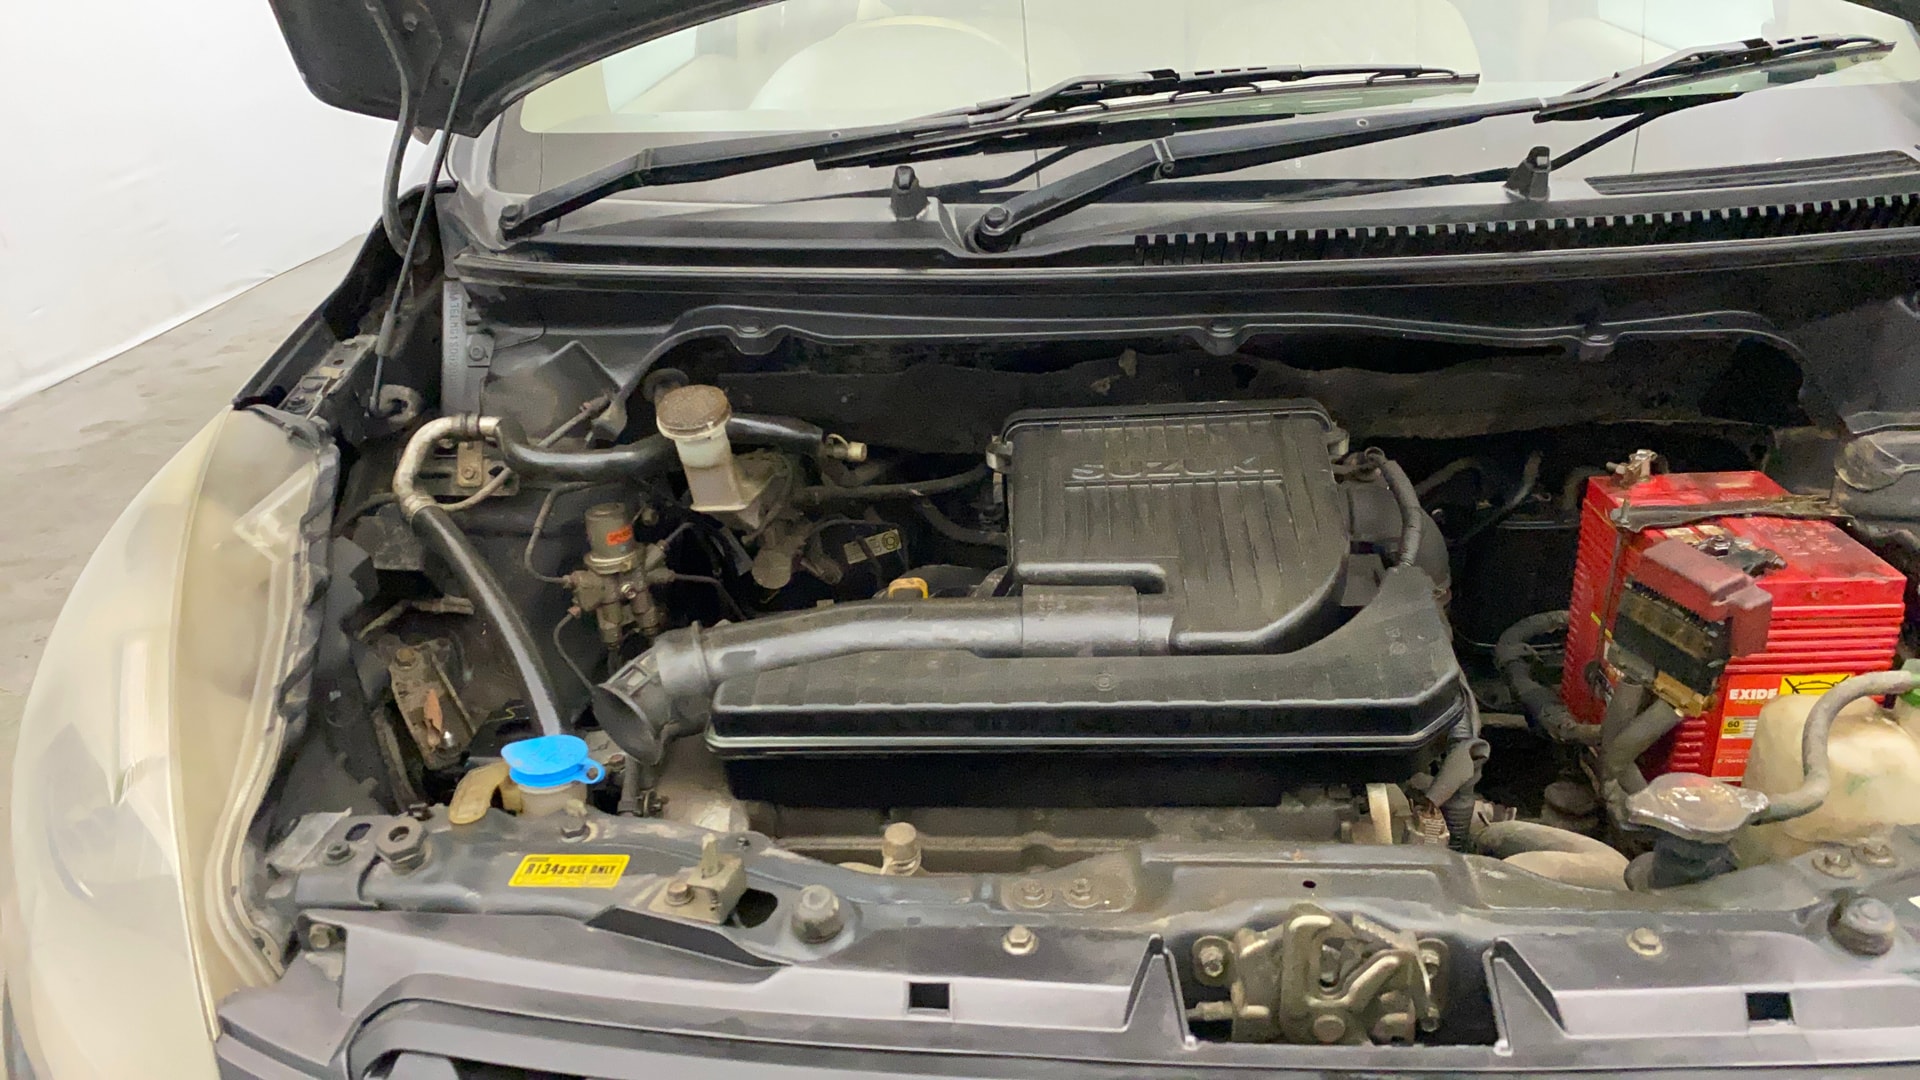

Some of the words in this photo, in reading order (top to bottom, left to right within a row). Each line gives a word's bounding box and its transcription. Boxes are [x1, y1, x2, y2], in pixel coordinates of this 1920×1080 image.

[1071, 456, 1275, 480] SUZUKI
[1729, 688, 1778, 700] EXIDE
[1727, 720, 1740, 729] 60
[525, 863, 567, 875] R134a
